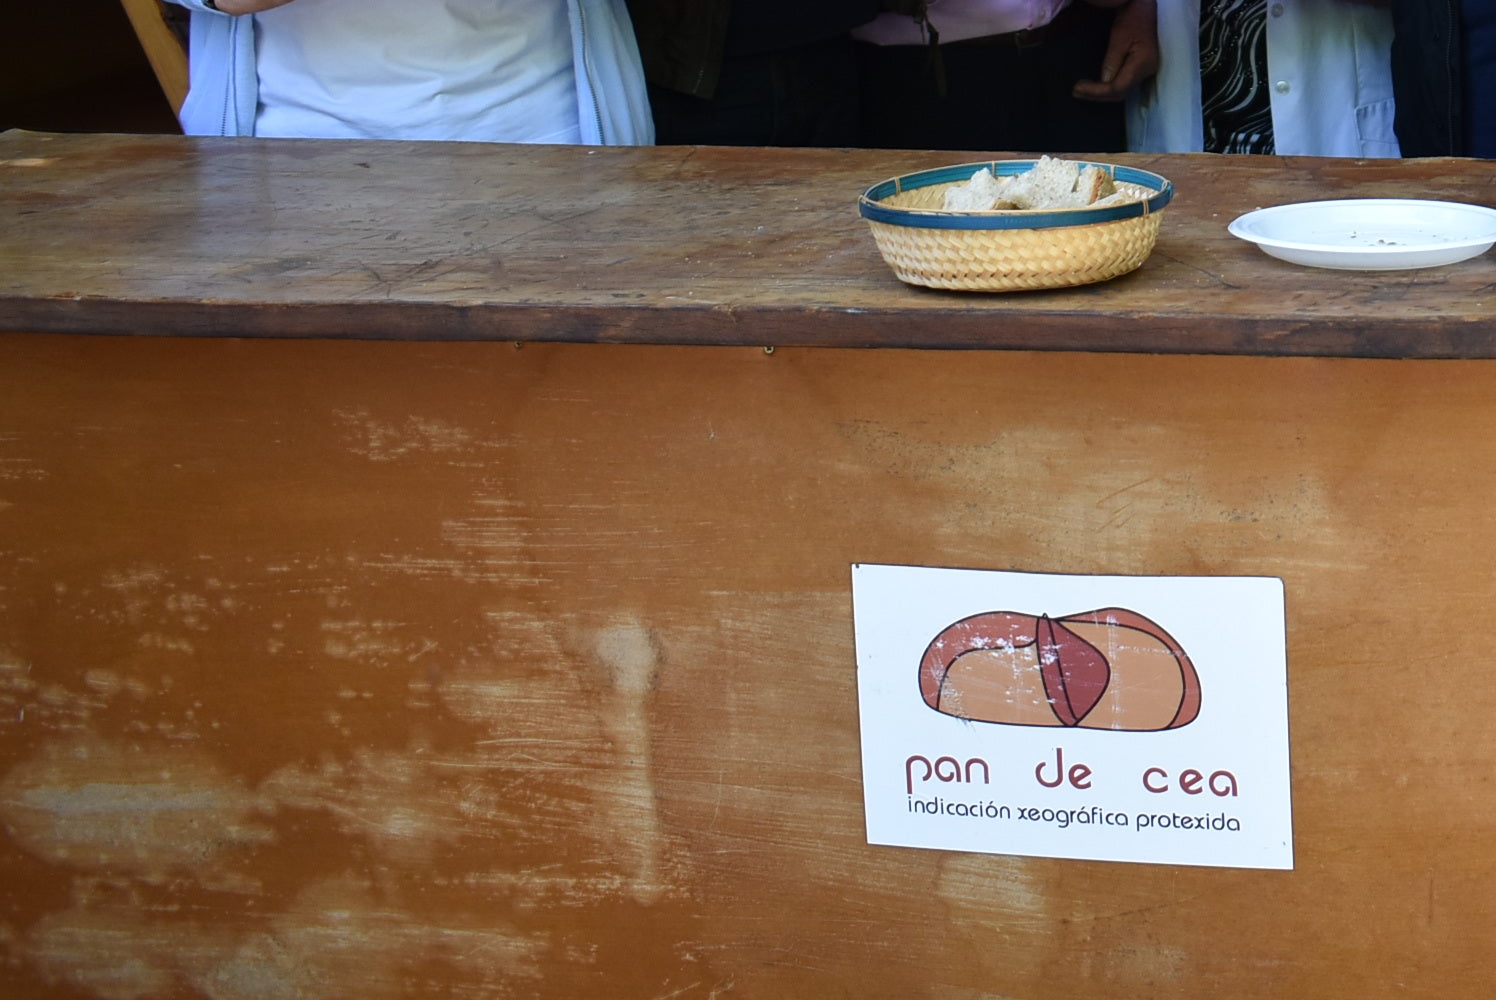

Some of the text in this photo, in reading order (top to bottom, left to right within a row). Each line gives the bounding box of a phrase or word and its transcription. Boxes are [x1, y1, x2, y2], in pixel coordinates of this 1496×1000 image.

[905, 747, 1239, 797] pan de cea
[907, 795, 1241, 832] indicación xeográfica protexida
